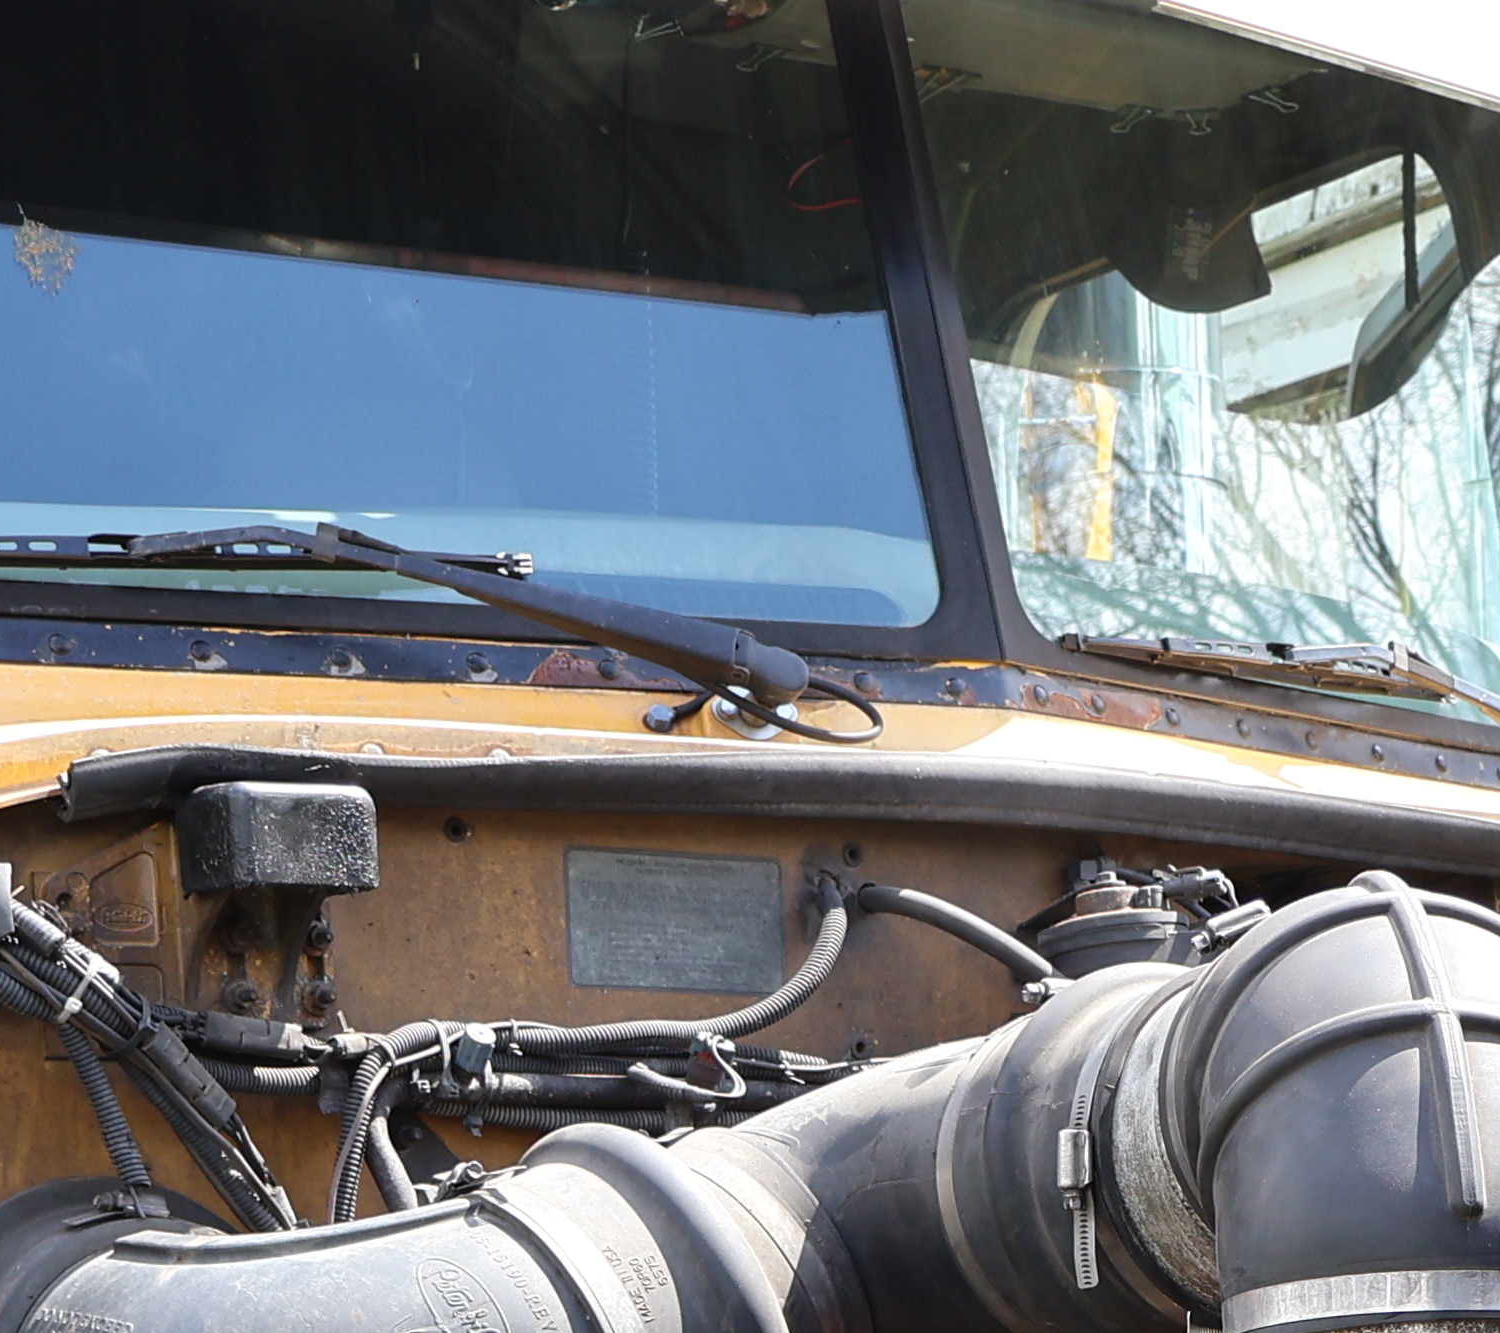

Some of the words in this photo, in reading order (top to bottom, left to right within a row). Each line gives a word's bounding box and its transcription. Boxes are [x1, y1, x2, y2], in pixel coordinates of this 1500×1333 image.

[601, 1244, 623, 1267] USA
[643, 1254, 669, 1287] 6575
[629, 1287, 655, 1324] MADE
